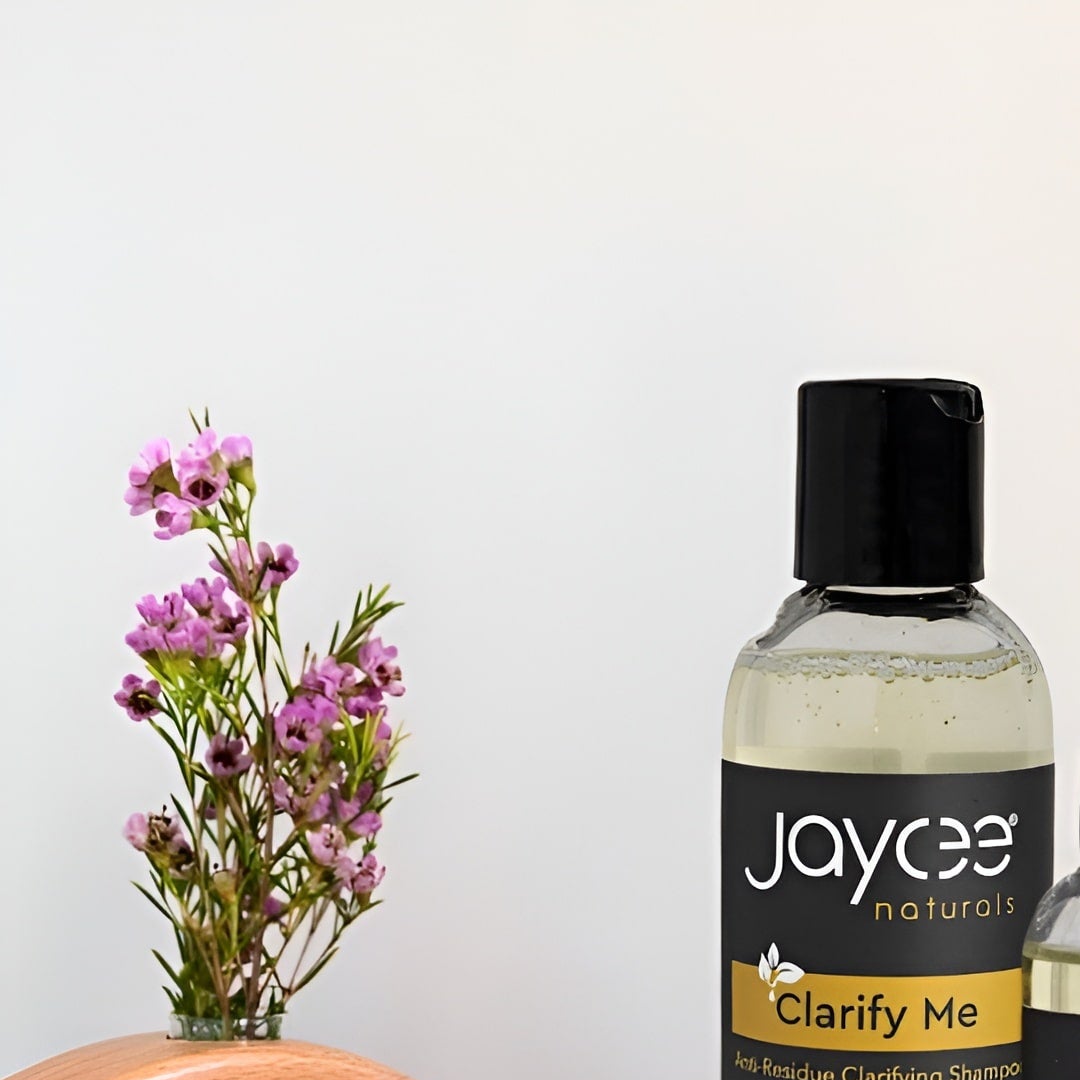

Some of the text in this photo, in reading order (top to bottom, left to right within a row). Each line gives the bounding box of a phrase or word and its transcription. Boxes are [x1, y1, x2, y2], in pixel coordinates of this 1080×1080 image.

[874, 892, 1014, 921] naturals
[776, 991, 978, 1039] Clarify Me
